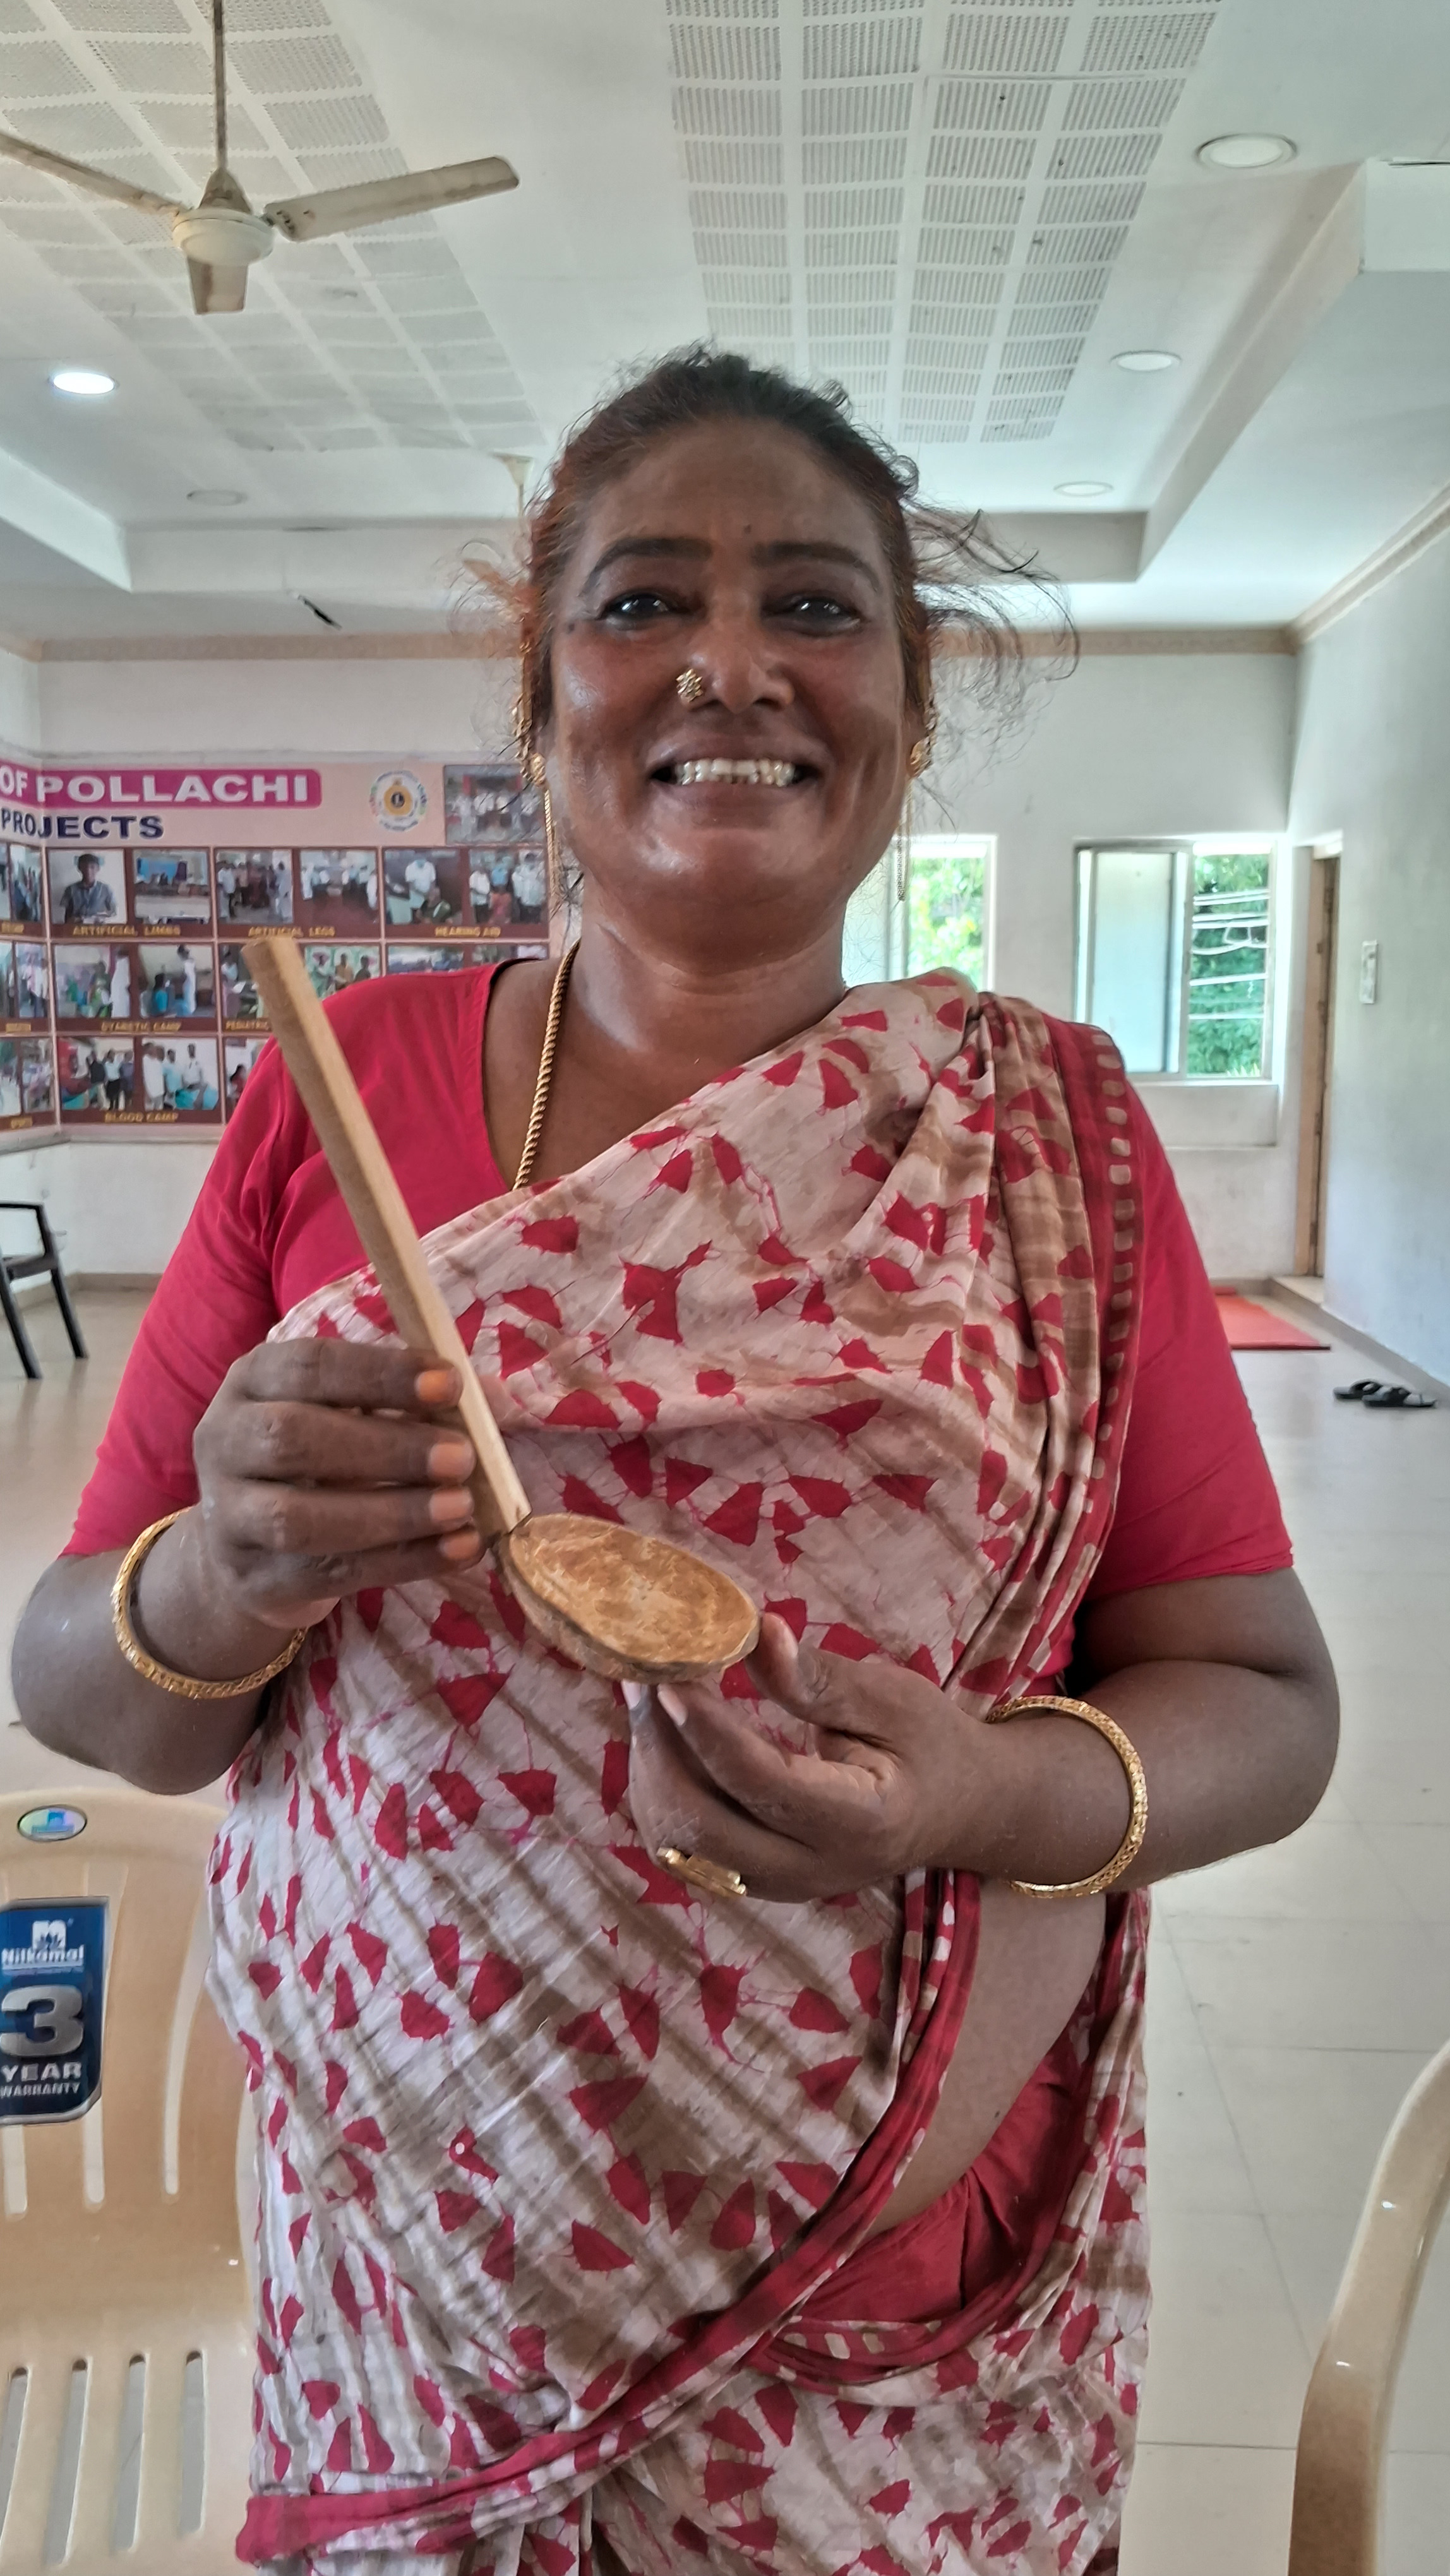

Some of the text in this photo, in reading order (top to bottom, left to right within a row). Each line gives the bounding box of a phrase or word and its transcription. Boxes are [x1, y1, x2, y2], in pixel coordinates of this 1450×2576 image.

[0, 764, 308, 803] OF POLLACHI
[1, 808, 165, 839] PROJECTS
[0, 1984, 84, 2058] 3
[1, 2061, 82, 2082] YEAR
